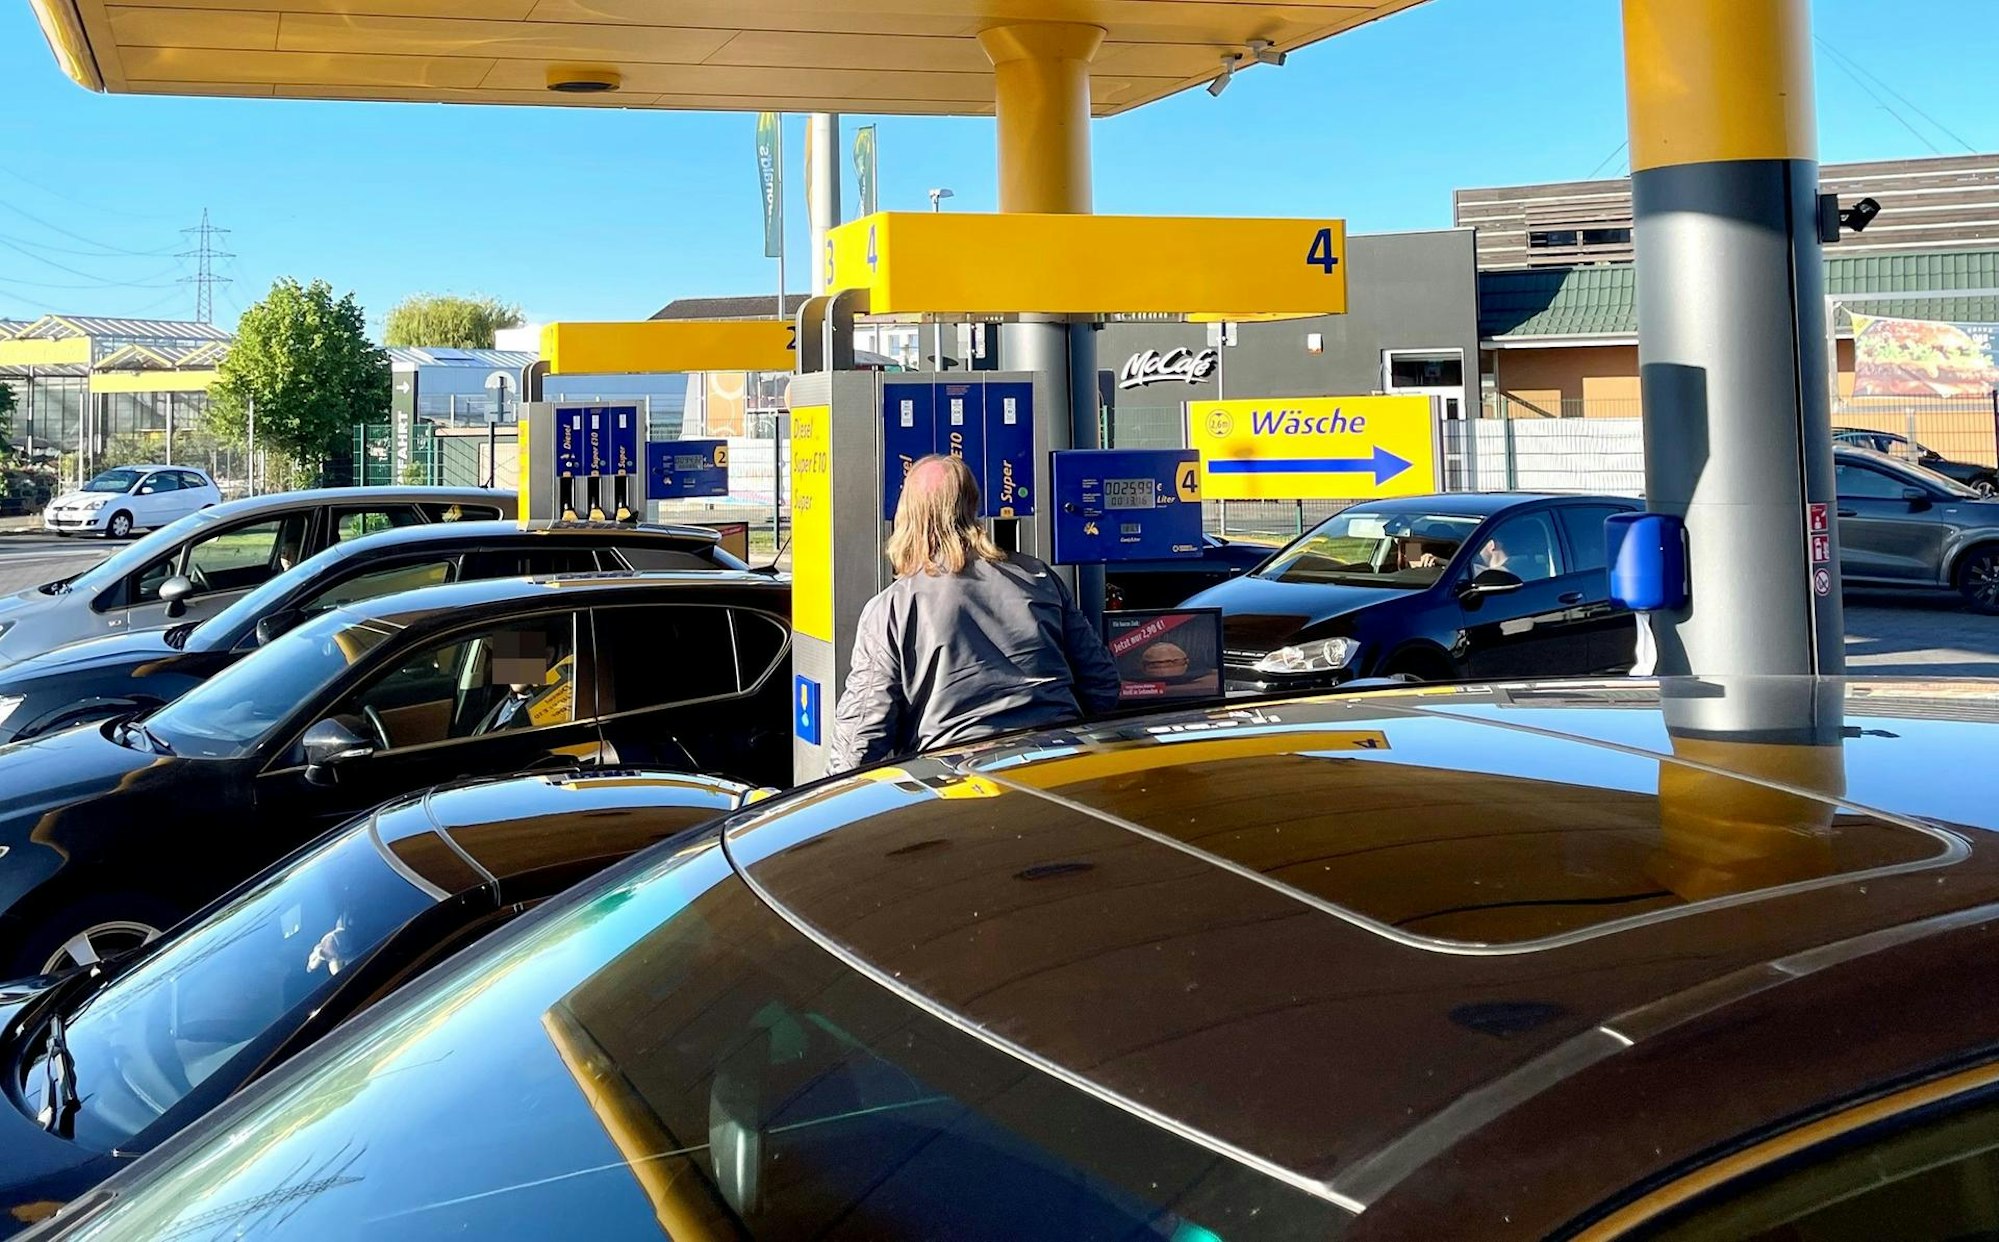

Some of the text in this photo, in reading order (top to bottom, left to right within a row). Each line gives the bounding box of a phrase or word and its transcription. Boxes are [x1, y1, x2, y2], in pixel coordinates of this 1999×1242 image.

[827, 239, 834, 285] 3
[867, 225, 878, 273] 4
[1307, 228, 1338, 274] 4
[786, 325, 796, 350] 2
[794, 416, 814, 438] Diesel
[1252, 408, 1365, 434] Wäsche
[563, 424, 572, 450] Diesel
[617, 445, 627, 469] Super
[718, 452, 726, 463] 2
[1001, 460, 1016, 503] Super
[1182, 470, 1198, 493] 4
[1157, 495, 1176, 504] Liter
[1113, 638, 1131, 653] Jetzt
[1130, 633, 1142, 645] nur
[1141, 624, 1157, 639] 2,90
